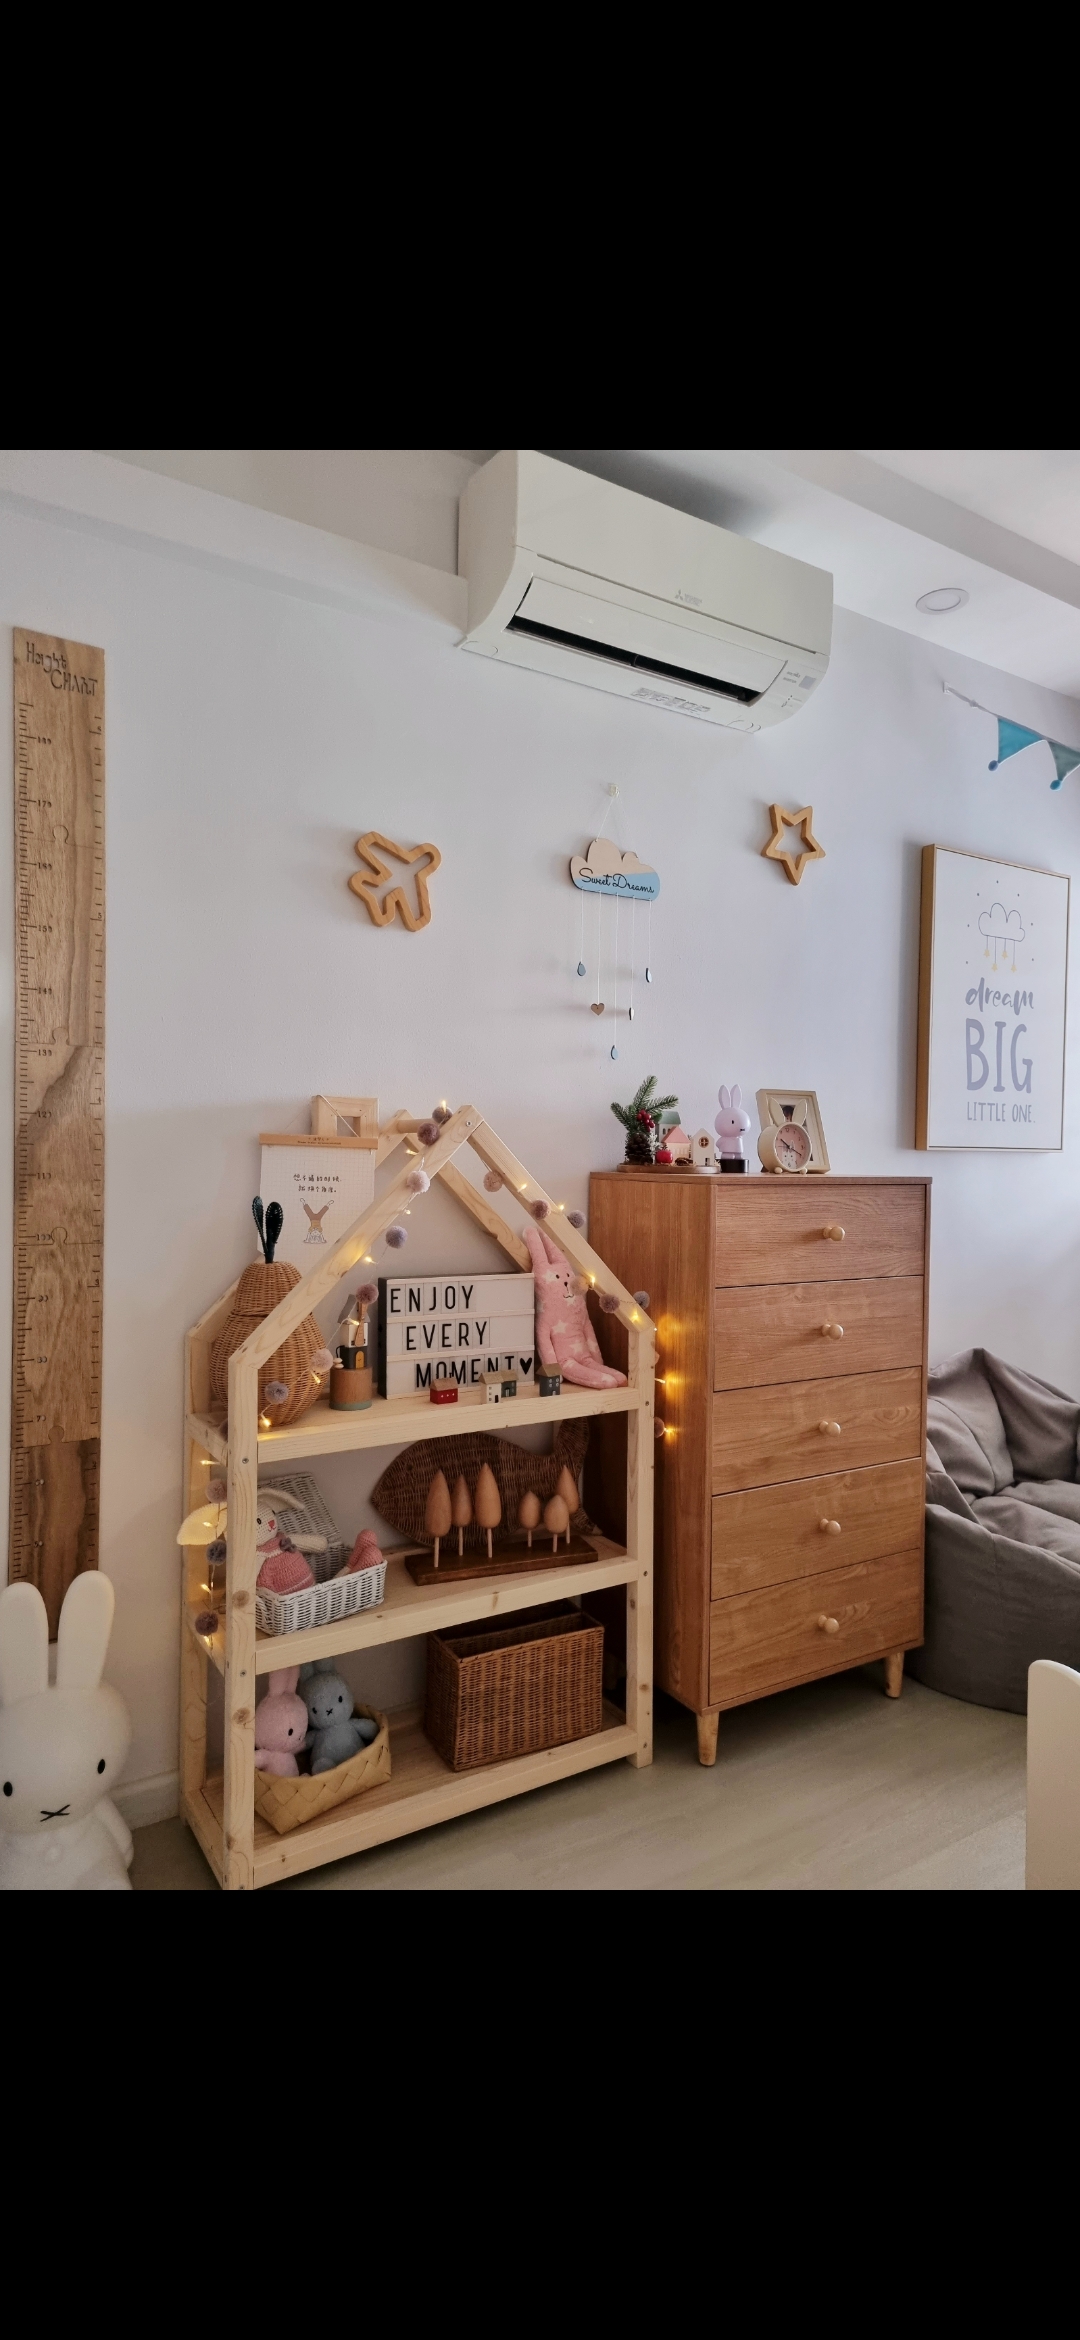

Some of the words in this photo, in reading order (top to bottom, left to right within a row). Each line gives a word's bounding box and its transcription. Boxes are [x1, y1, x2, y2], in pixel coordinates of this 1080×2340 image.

[26, 641, 67, 673] Height
[50, 669, 98, 696] CHART
[579, 867, 613, 887] Sweet
[612, 873, 655, 893] Dreams
[965, 977, 1034, 1016] dream
[965, 1018, 1034, 1094] BIG
[967, 1101, 1006, 1122] LITTLE
[1012, 1103, 1036, 1124] ONE.
[390, 1285, 474, 1313] ENJOY
[406, 1321, 487, 1350] EVERY
[416, 1355, 515, 1388] MOMENT
